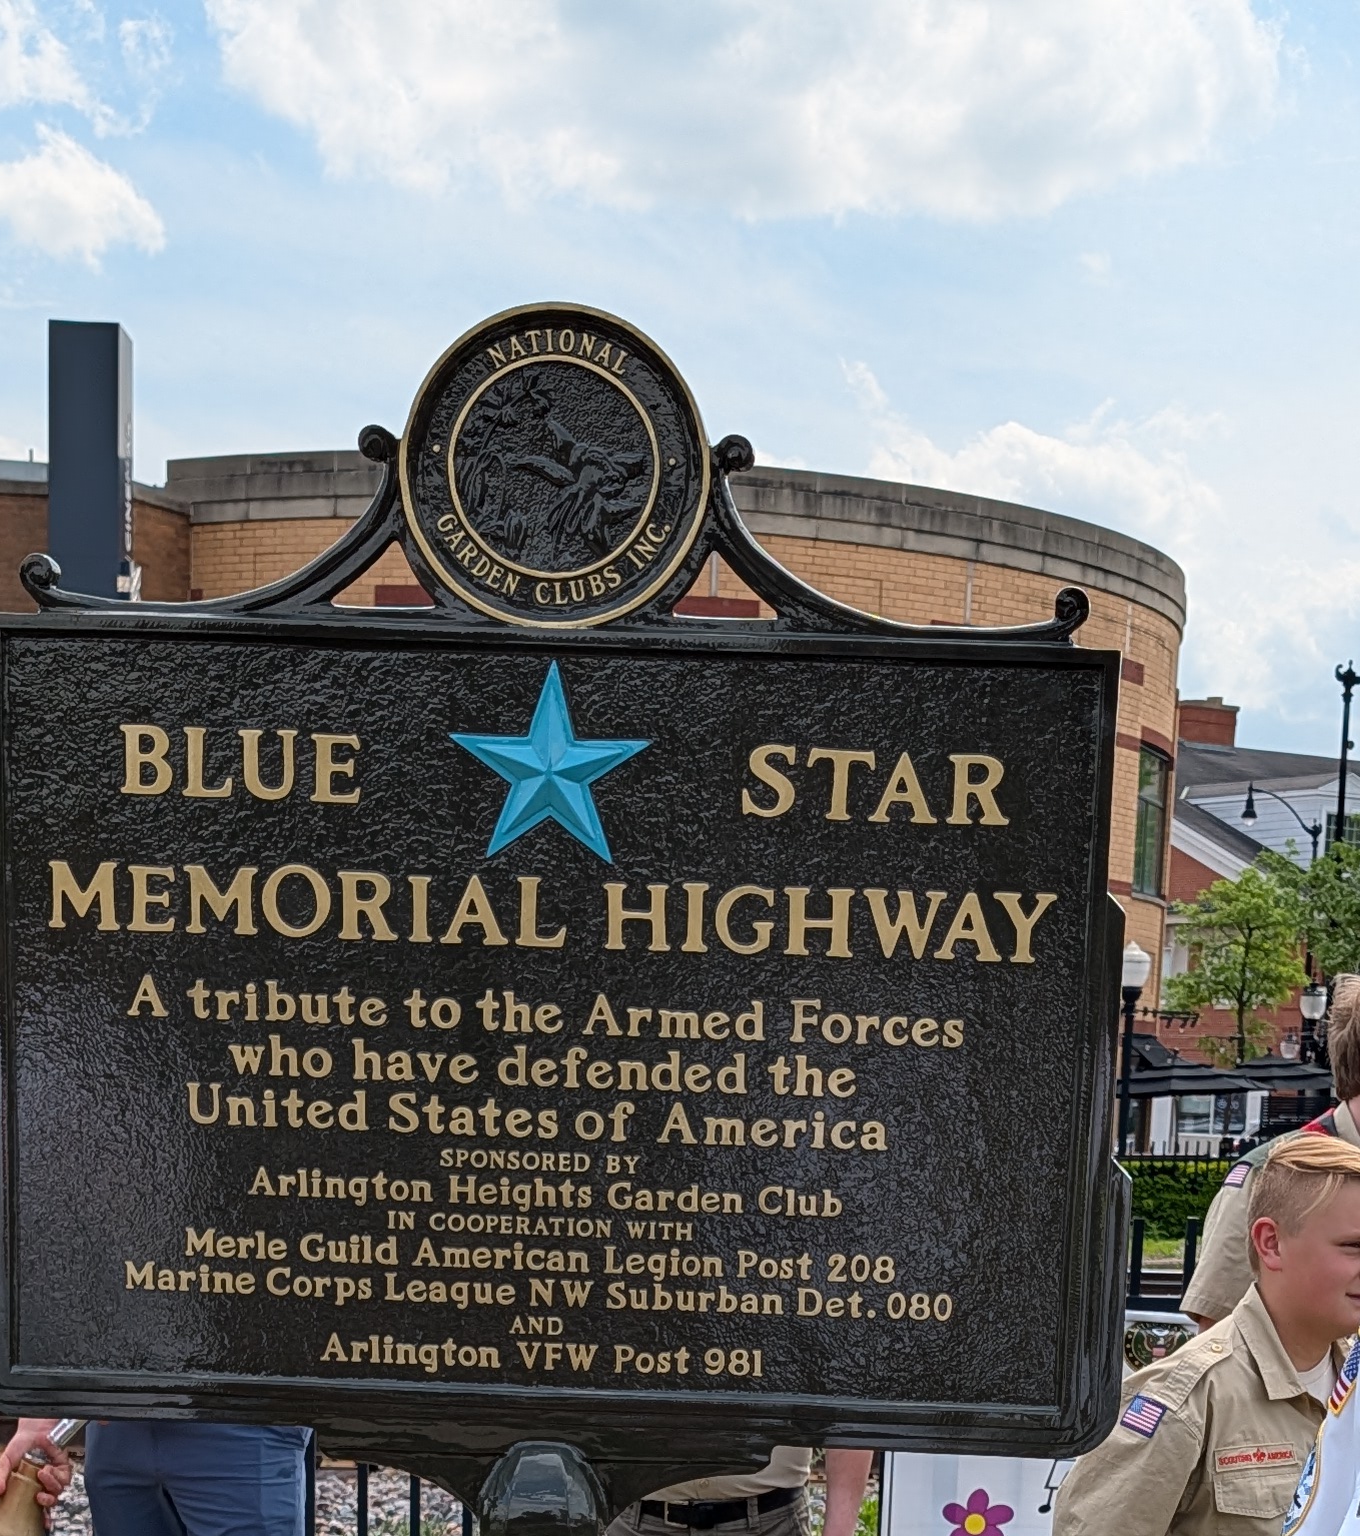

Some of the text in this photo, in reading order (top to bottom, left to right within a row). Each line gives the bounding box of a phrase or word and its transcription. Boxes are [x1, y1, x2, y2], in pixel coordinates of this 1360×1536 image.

[488, 328, 629, 377] NATIONAL
[436, 513, 672, 605] GARDEN CLUBS INC.
[120, 724, 1008, 825] BLUE STAR
[49, 860, 1057, 963] MEMORIAL HIGHWAY
[128, 975, 963, 1047] A tribute to the Armed Forces
[229, 1035, 856, 1097] who have defended the
[187, 1082, 887, 1150] United States of America
[440, 1150, 639, 1173] SPONSORED BY
[250, 1166, 842, 1217] Arlington Heights Garden Club
[388, 1211, 691, 1240] IN COOPERATION WITH
[185, 1228, 895, 1283] Merle Guild American Legion Post 208
[126, 1261, 952, 1321] Marine Corps League NW Suburban Det. 080
[321, 1333, 762, 1376] Arlington VFW Post 981
[509, 1317, 563, 1335] AND
